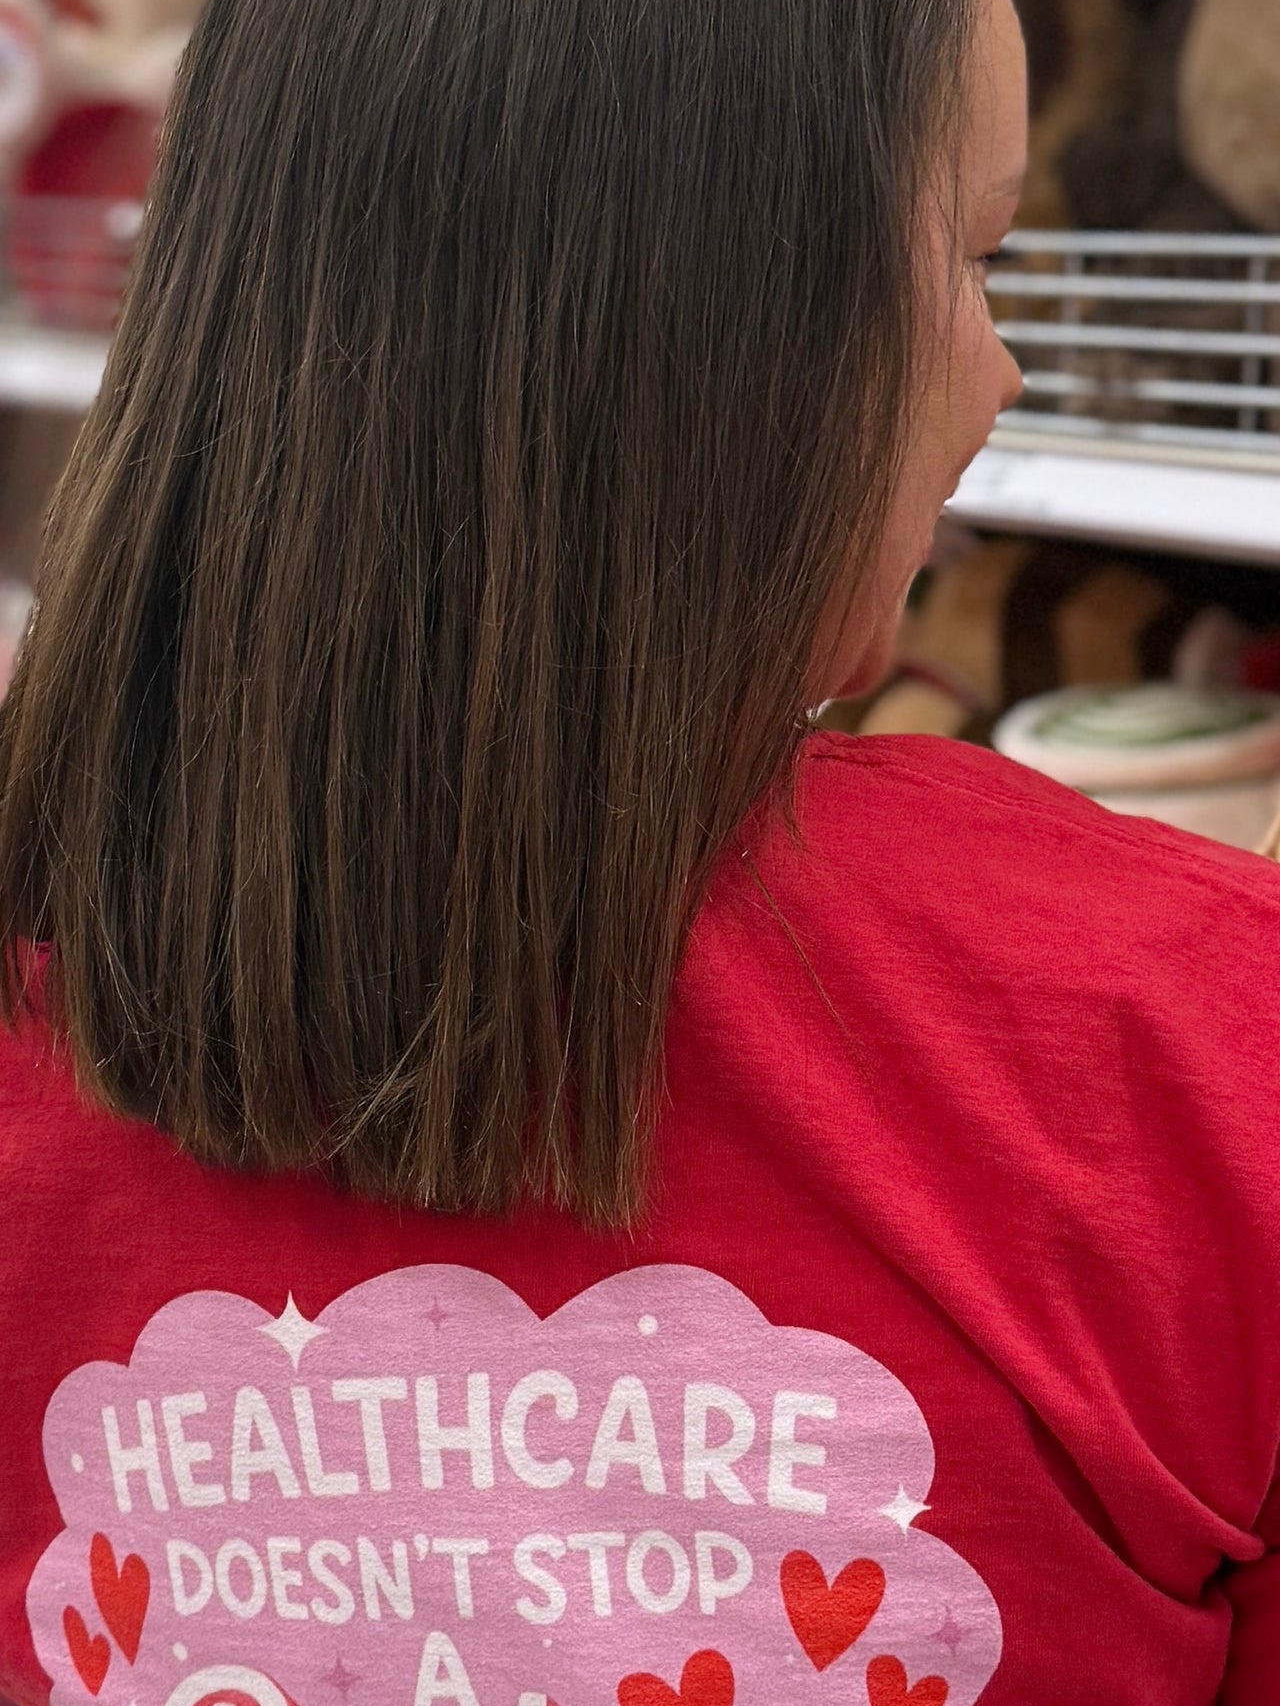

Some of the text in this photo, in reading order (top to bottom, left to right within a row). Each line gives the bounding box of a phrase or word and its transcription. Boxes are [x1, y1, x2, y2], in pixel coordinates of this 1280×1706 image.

[100, 1368, 839, 1516] HEALTHCARE
[165, 1529, 755, 1626] DOESN'T STOP
